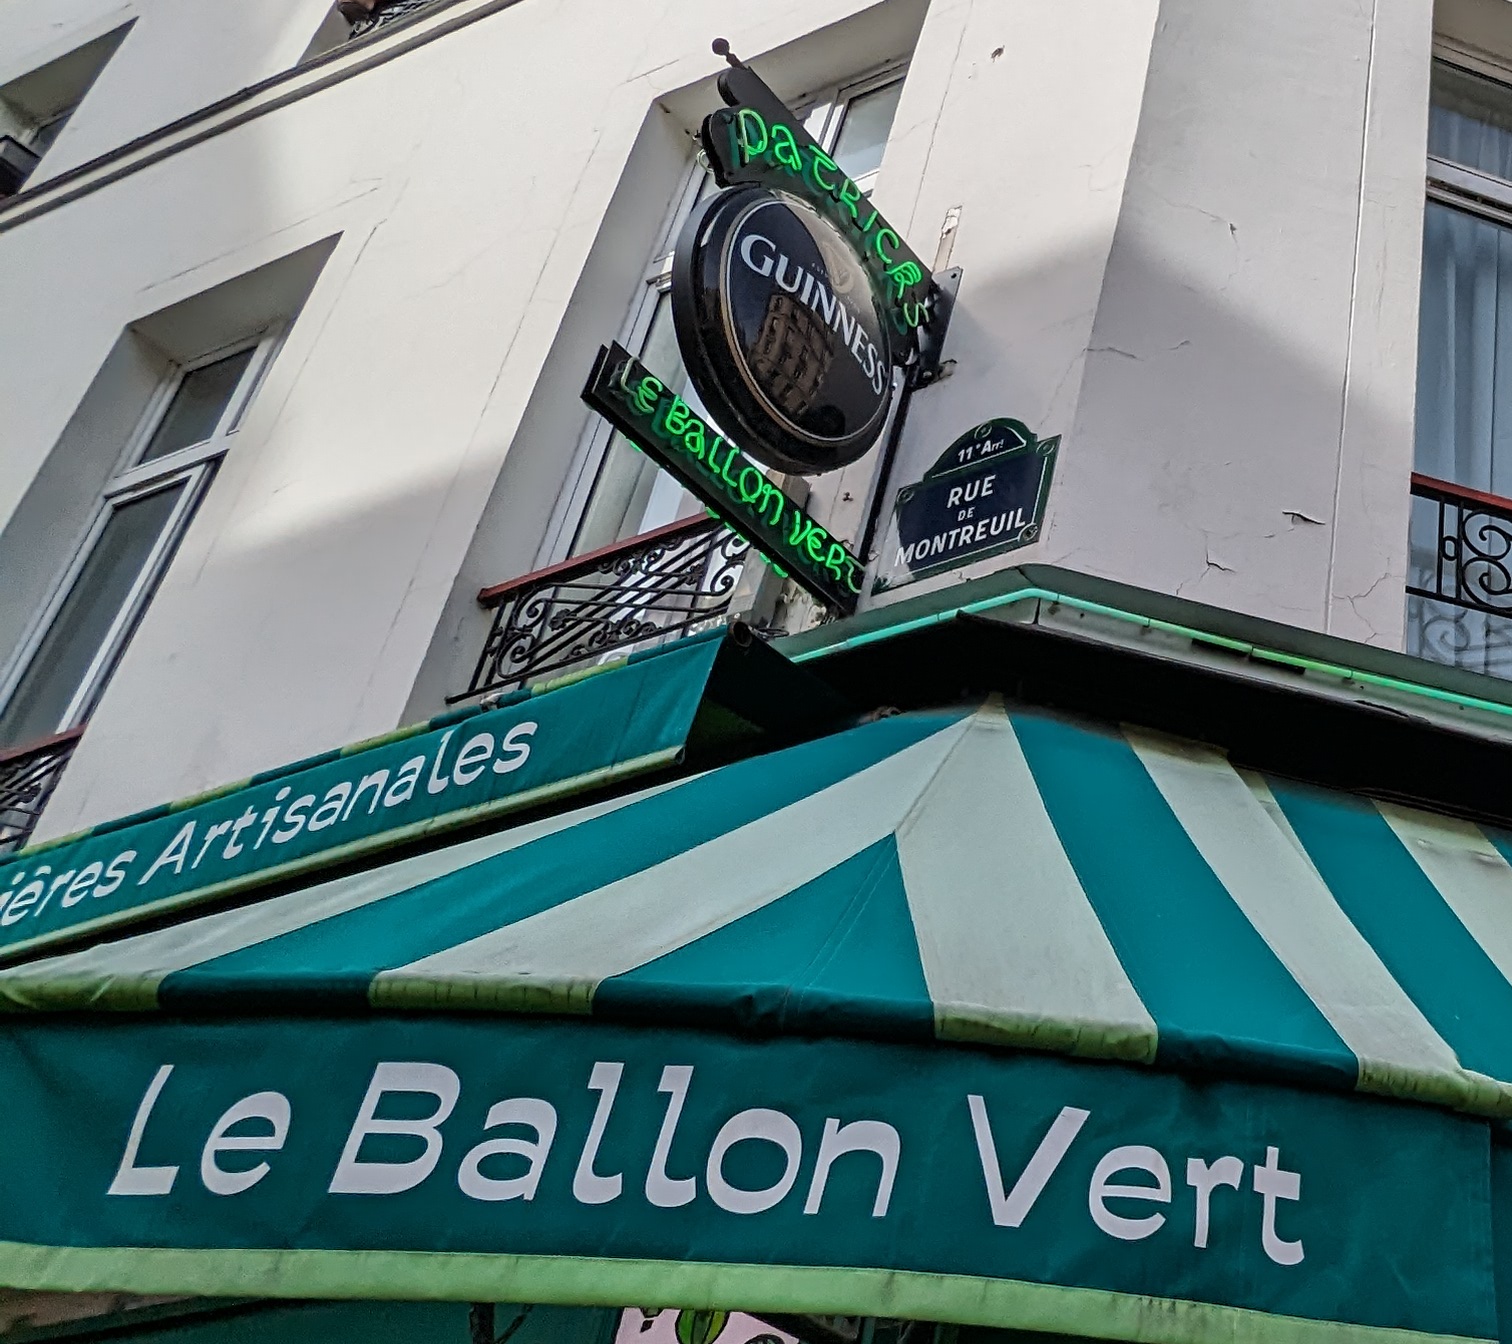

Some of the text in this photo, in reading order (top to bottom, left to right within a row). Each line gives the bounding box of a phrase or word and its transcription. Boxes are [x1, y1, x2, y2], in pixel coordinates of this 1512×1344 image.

[740, 233, 888, 397] GUINNESS
[893, 507, 1027, 567] MONTREUIL
[946, 474, 996, 509] RUE
[957, 506, 976, 522] DE
[137, 719, 539, 886] Artisanales
[105, 1060, 1305, 1266] Le Ballon Vert
